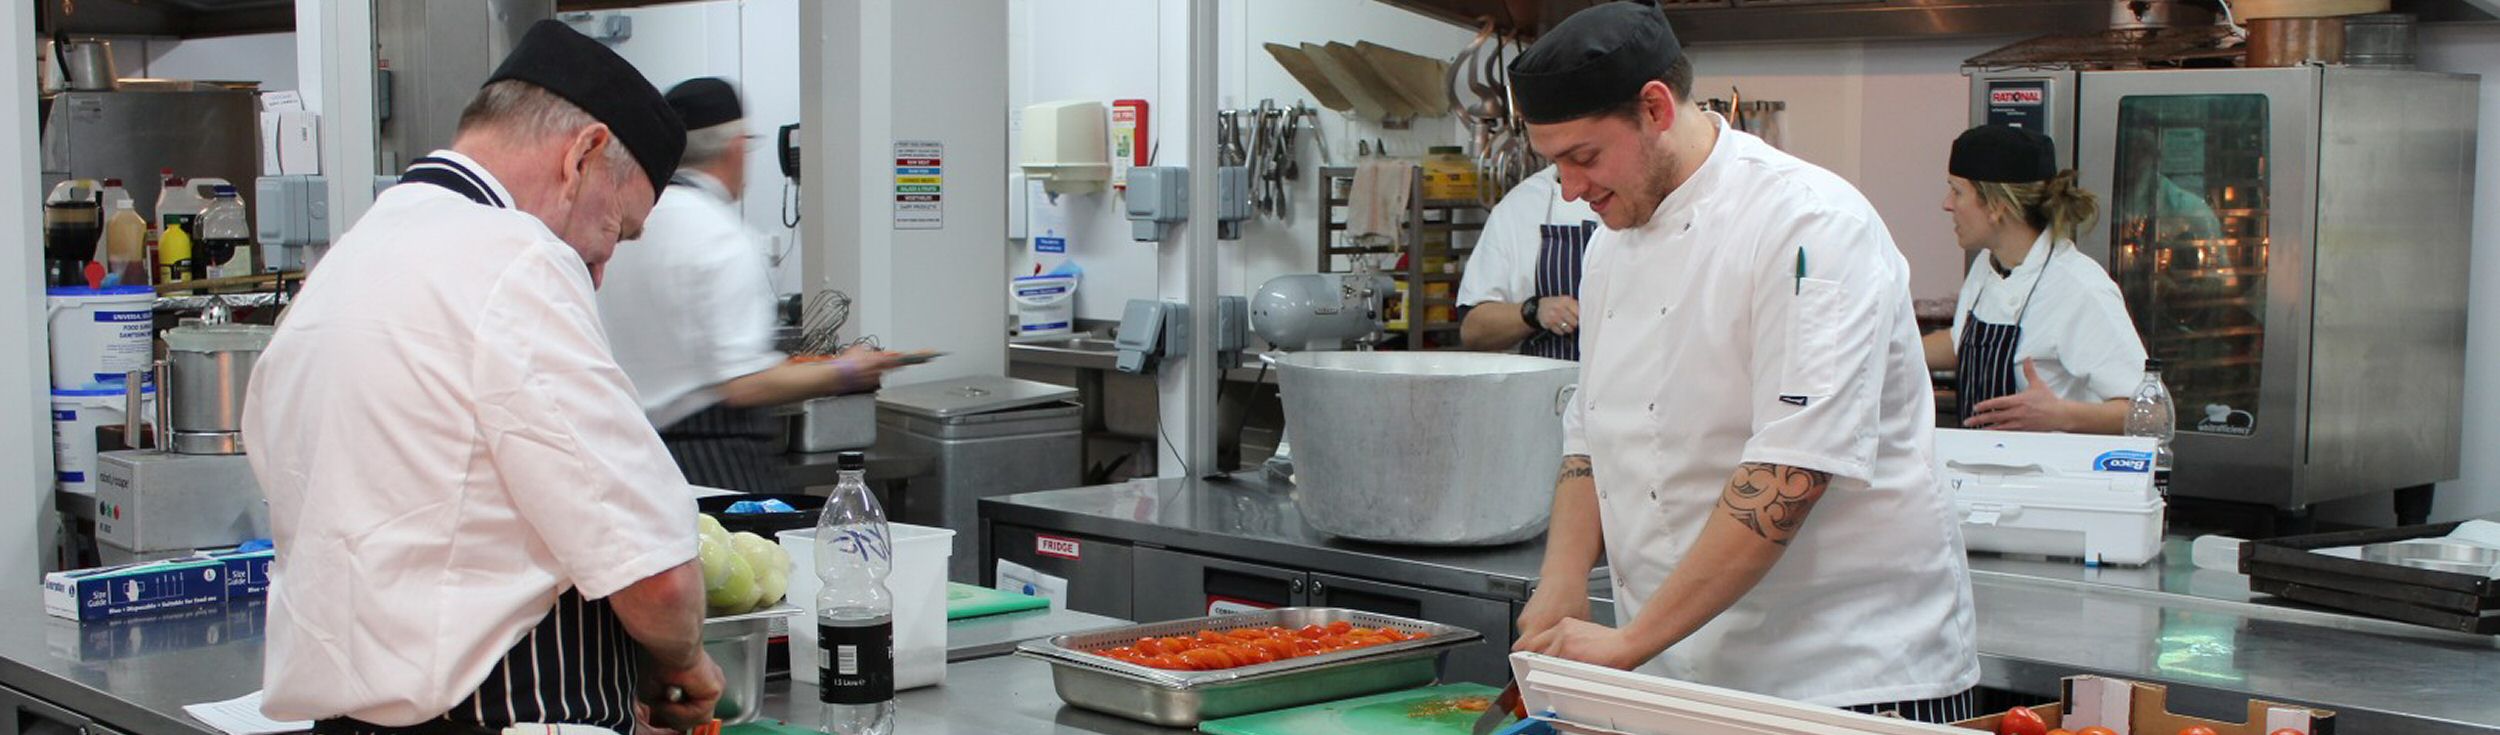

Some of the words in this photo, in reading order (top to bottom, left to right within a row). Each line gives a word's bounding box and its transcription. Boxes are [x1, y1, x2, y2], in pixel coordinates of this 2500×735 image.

[1993, 91, 2039, 102] RATIONAL
[2110, 460, 2145, 470] Baco
[1043, 540, 1073, 552] FRIDGE
[92, 591, 107, 600] Size
